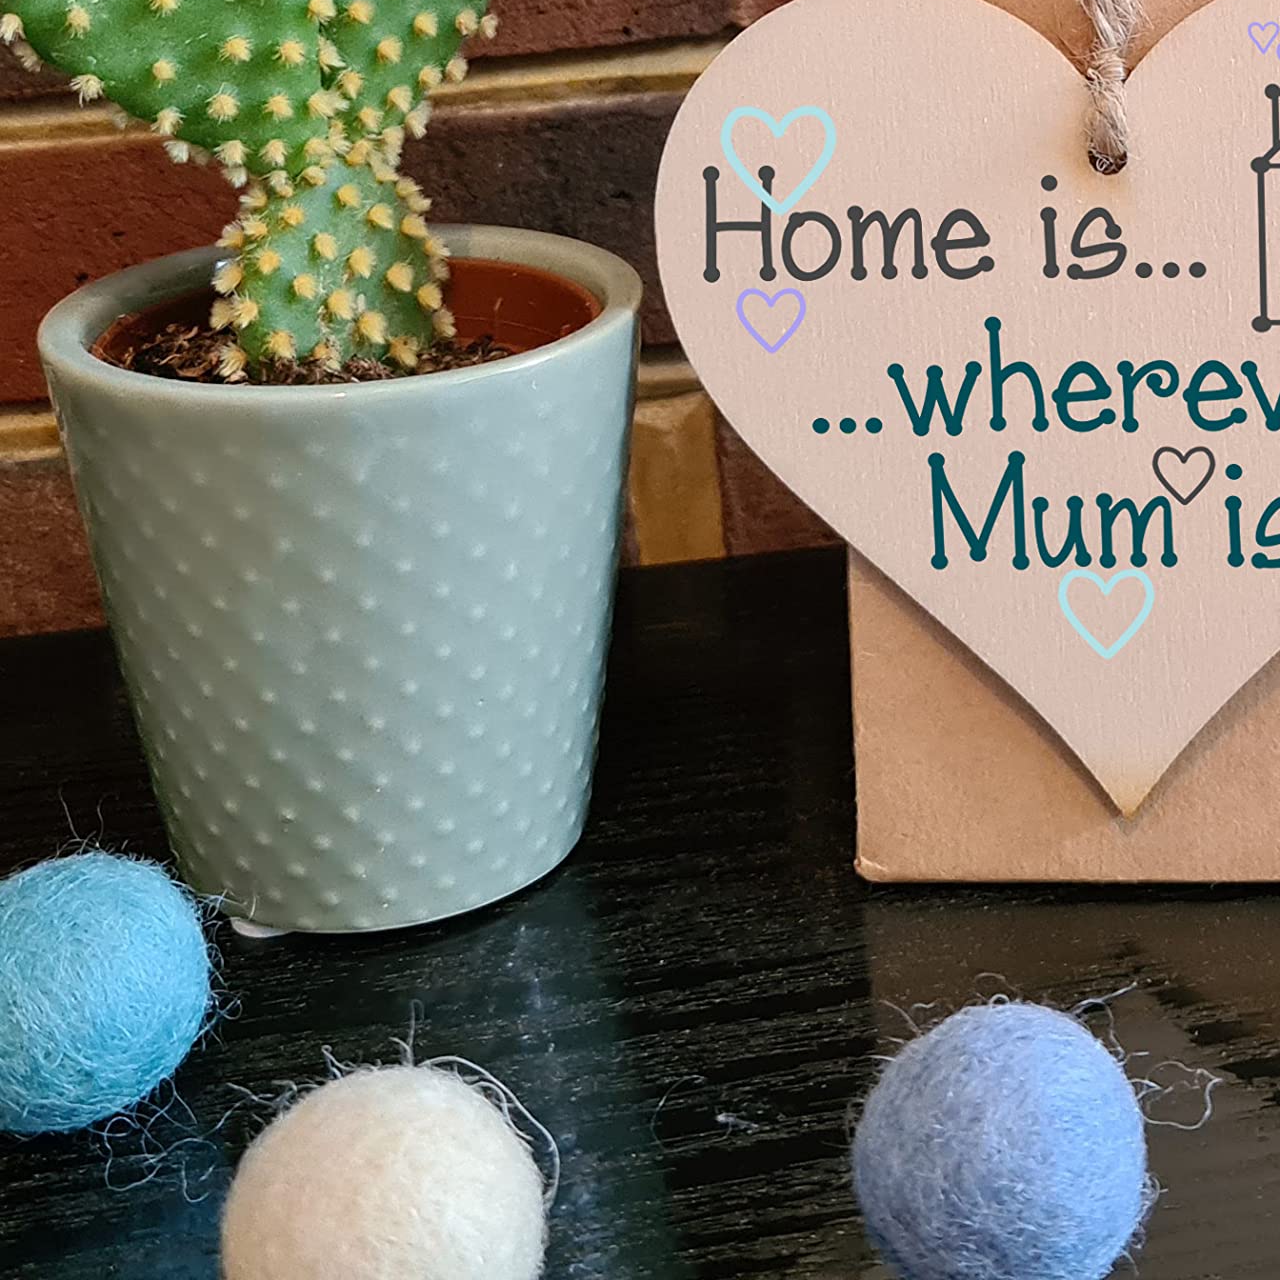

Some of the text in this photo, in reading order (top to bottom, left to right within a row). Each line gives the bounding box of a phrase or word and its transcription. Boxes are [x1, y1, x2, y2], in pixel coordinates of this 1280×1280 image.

[702, 165, 1207, 283] Home is...
[927, 450, 1178, 571] Mum
